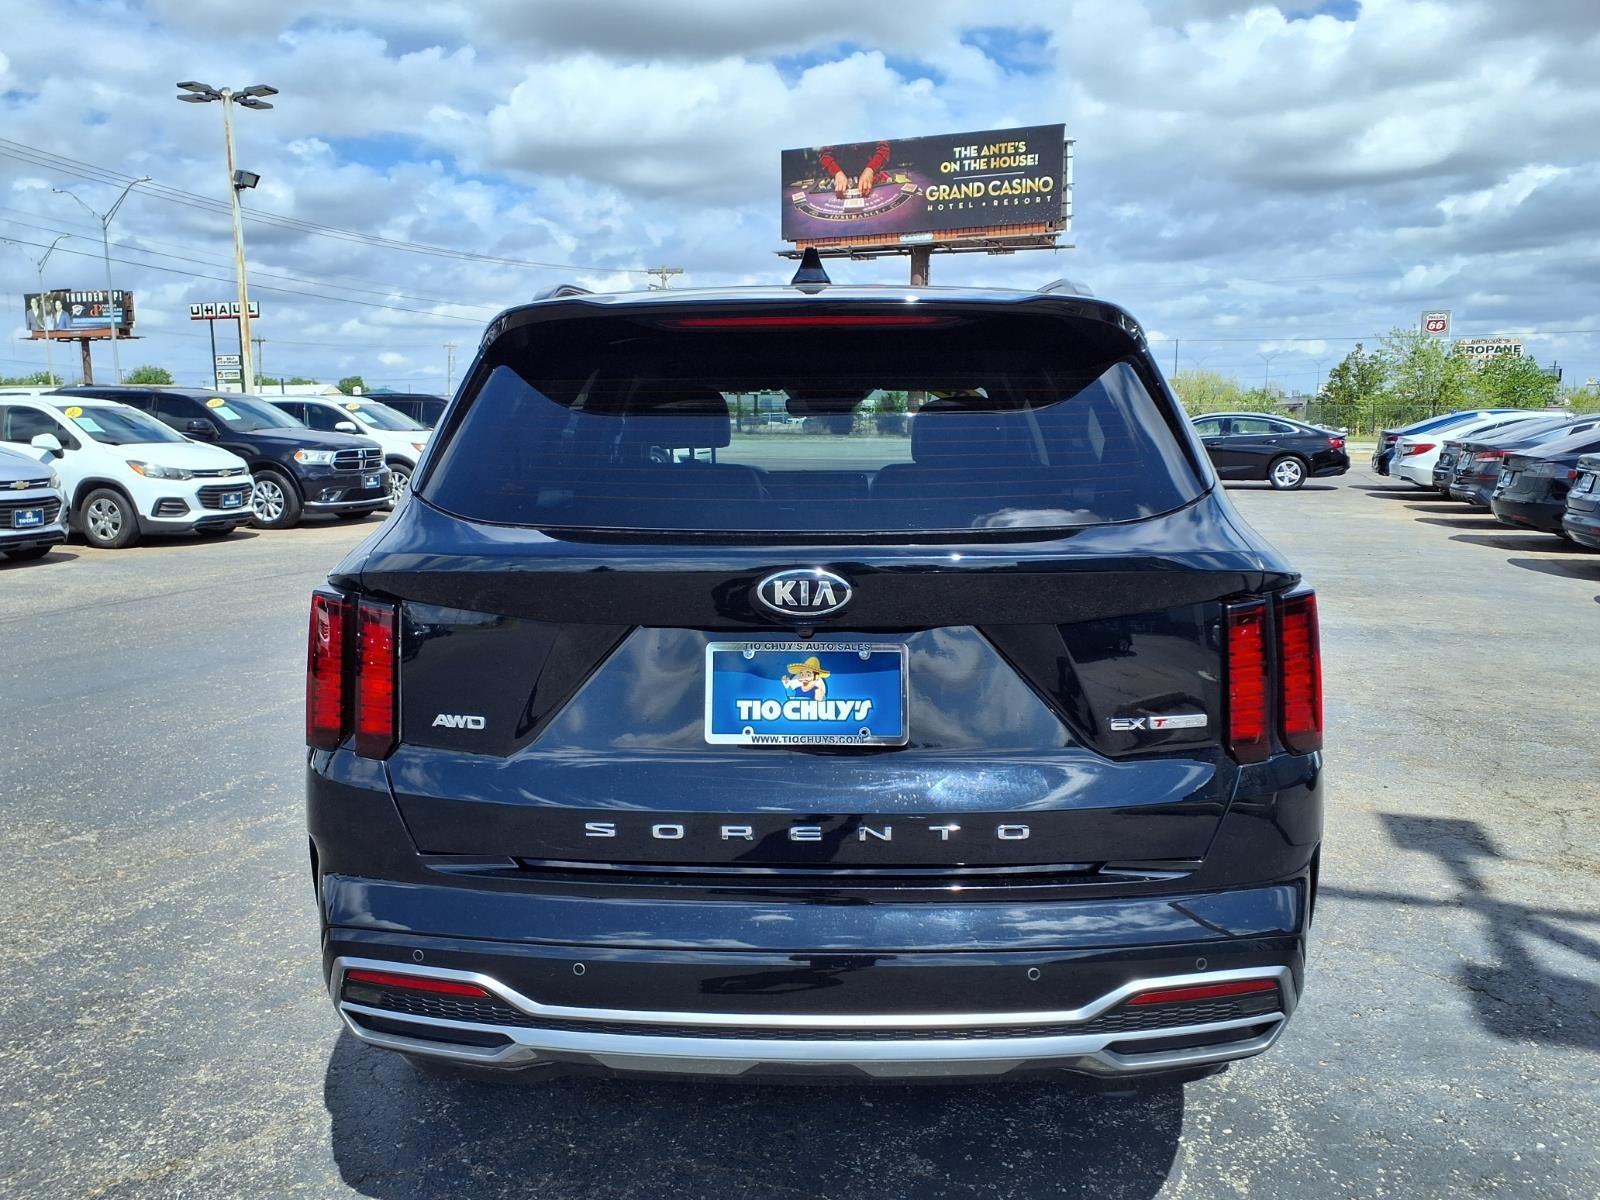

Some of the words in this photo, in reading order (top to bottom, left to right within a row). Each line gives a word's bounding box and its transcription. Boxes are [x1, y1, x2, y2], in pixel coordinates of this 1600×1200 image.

[953, 146, 978, 158] THE
[981, 141, 1026, 156] ANTE'S
[940, 161, 960, 173] ON
[963, 159, 987, 171] THE
[990, 154, 1039, 169] HOUSE!
[925, 181, 985, 201] GRAND
[988, 176, 1054, 196] CASINO
[927, 202, 974, 211] HOTEL
[993, 195, 1052, 206] RESORT
[65, 292, 104, 303] THUNDER
[1428, 320, 1444, 330] 66
[773, 580, 837, 606] KIA
[744, 643, 761, 651] TIO
[764, 643, 803, 651] CHUY'S
[806, 643, 834, 651] AUTO
[837, 643, 871, 651] SALES
[736, 699, 782, 721] TIO
[431, 713, 486, 730] AWD
[1110, 717, 1146, 731] EX
[751, 735, 866, 744] WWW.TIOCHUYS.COM
[585, 822, 1030, 841] SORENTO
